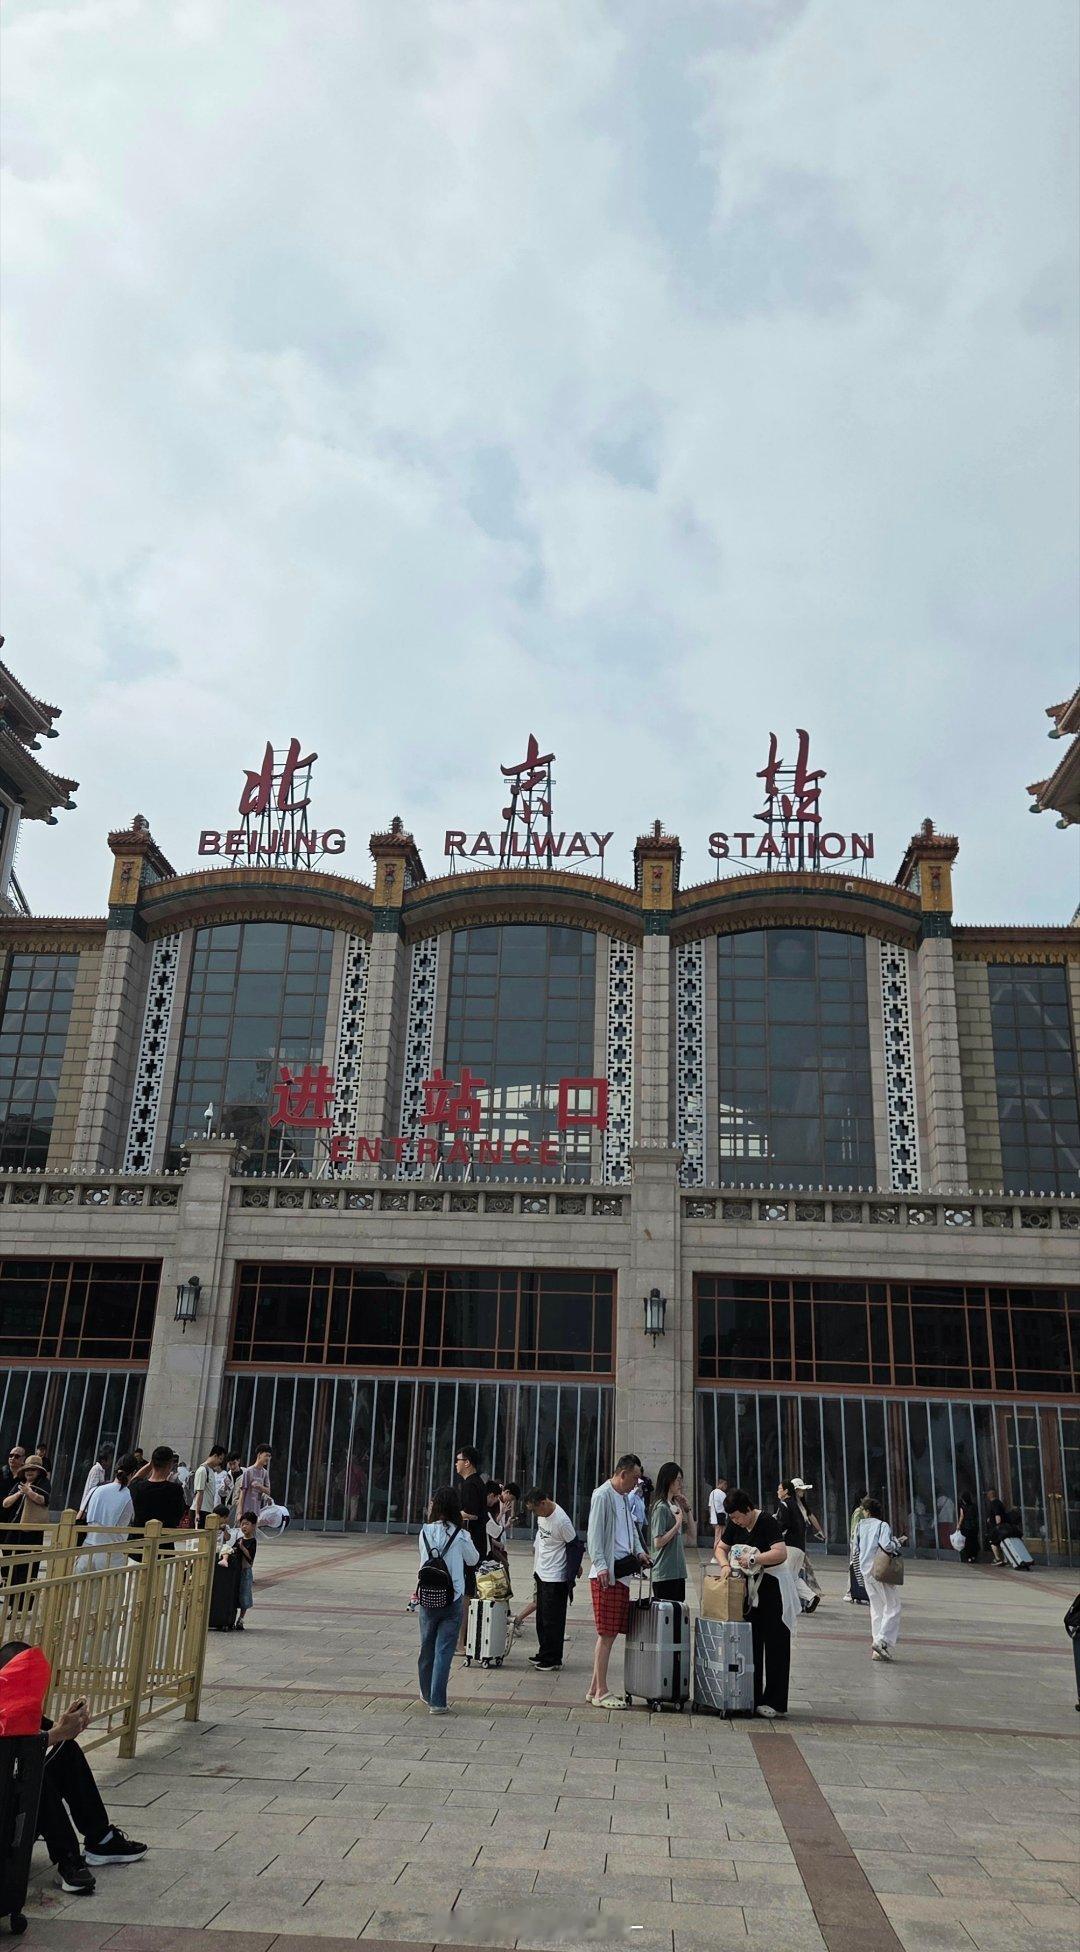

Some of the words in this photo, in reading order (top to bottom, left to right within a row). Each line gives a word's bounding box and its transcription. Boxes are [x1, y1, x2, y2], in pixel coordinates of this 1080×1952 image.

[238, 729, 826, 823] 北京站
[198, 829, 346, 855] BEIJING
[445, 831, 614, 857] RAILWAY
[708, 832, 873, 858] STATION
[269, 1065, 608, 1131] 进站口
[330, 1136, 561, 1166] ENTRANCE
